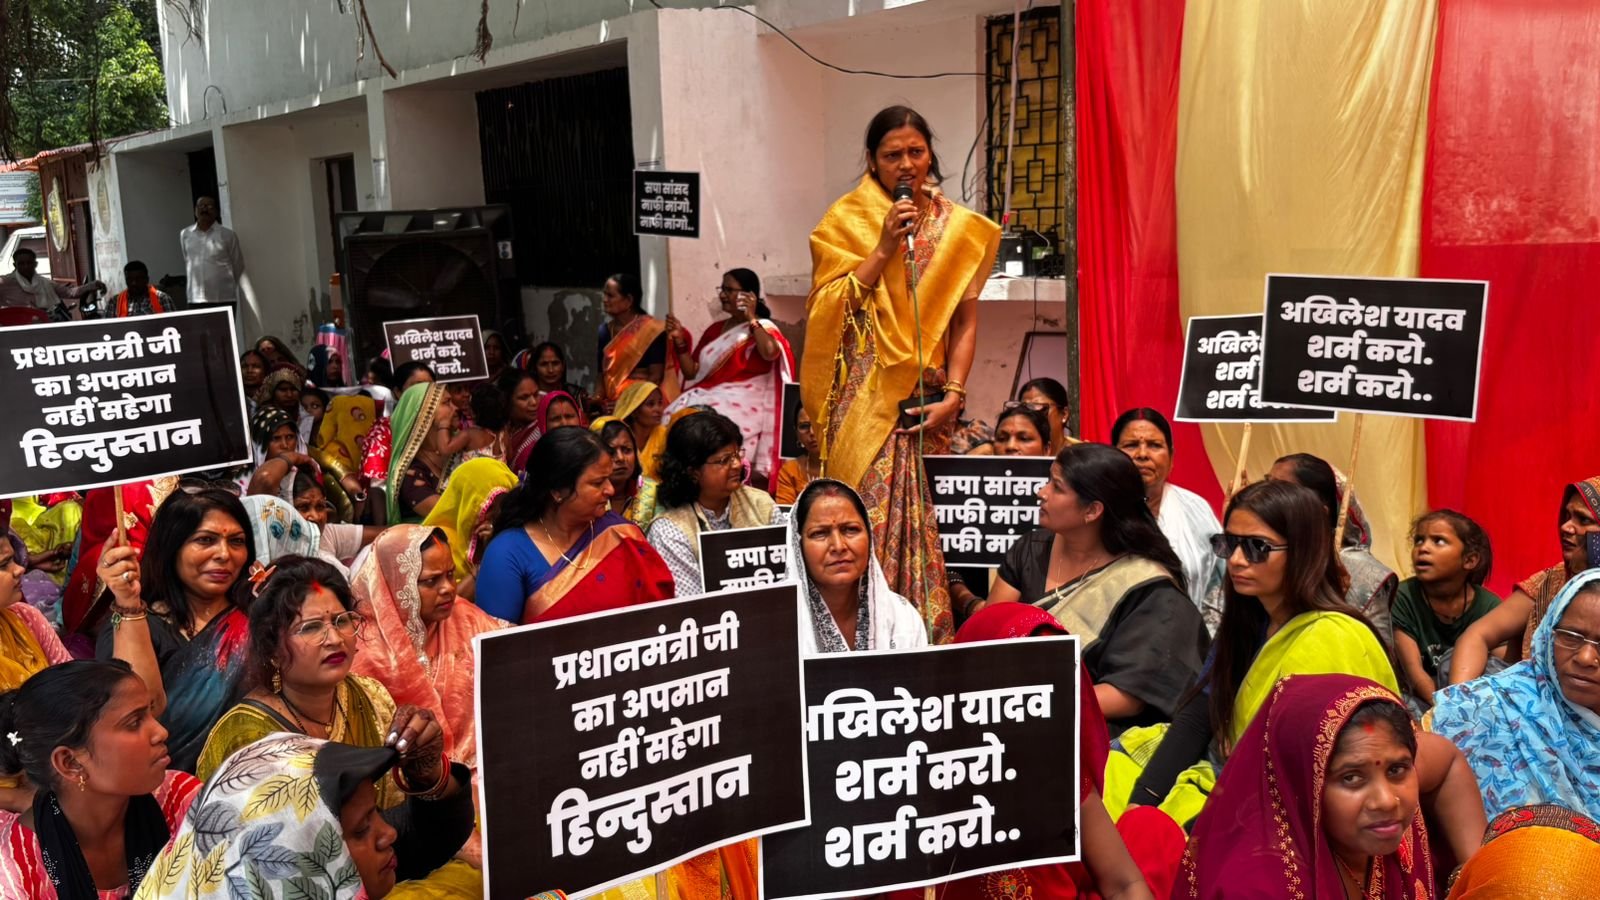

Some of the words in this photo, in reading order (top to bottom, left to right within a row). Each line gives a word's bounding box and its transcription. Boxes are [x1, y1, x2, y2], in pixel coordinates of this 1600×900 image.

[644, 182, 662, 194] सपा
[662, 179, 690, 196] सांसद
[641, 196, 664, 212] माफी
[665, 197, 693, 213] मांगो.
[640, 212, 663, 228] माफी
[664, 214, 694, 231] मांगो..
[1280, 295, 1390, 328] अखिलेश
[1393, 306, 1466, 332] यादव
[11, 331, 144, 370] प्रधानमंत्री
[146, 327, 181, 354] जी
[394, 329, 443, 345] अखिलेश
[444, 328, 473, 340] यादव
[411, 343, 436, 360] शर्म
[436, 342, 466, 357] करो.
[1197, 330, 1262, 354] अखिले
[1306, 330, 1368, 361] शर्म
[1365, 333, 1433, 365] करो.
[32, 375, 71, 396] का
[76, 364, 176, 392] अपमान
[1206, 383, 1252, 409] शर्म
[1298, 365, 1357, 395] शर्म
[1355, 368, 1432, 402] करो..
[42, 396, 99, 426] नहीं
[98, 393, 172, 420] सहेगा
[20, 418, 202, 473] हिन्दुस्तान
[934, 476, 981, 494] सपा
[989, 499, 1041, 525] मांग
[939, 526, 982, 553] ाफी
[725, 546, 766, 569] सपा
[552, 617, 698, 690] प्रधानमंत्री
[702, 610, 740, 652] जी
[571, 693, 616, 732] का
[622, 667, 730, 719] अपमान
[959, 684, 1054, 725] यादव
[578, 725, 645, 781] नहीं
[644, 714, 721, 765] सहेगा
[835, 740, 928, 802] शर्म
[926, 732, 1017, 790] करो.
[546, 754, 752, 858] हिन्दुस्तान
[824, 805, 918, 868] शर्म
[915, 794, 1020, 855] करो..
